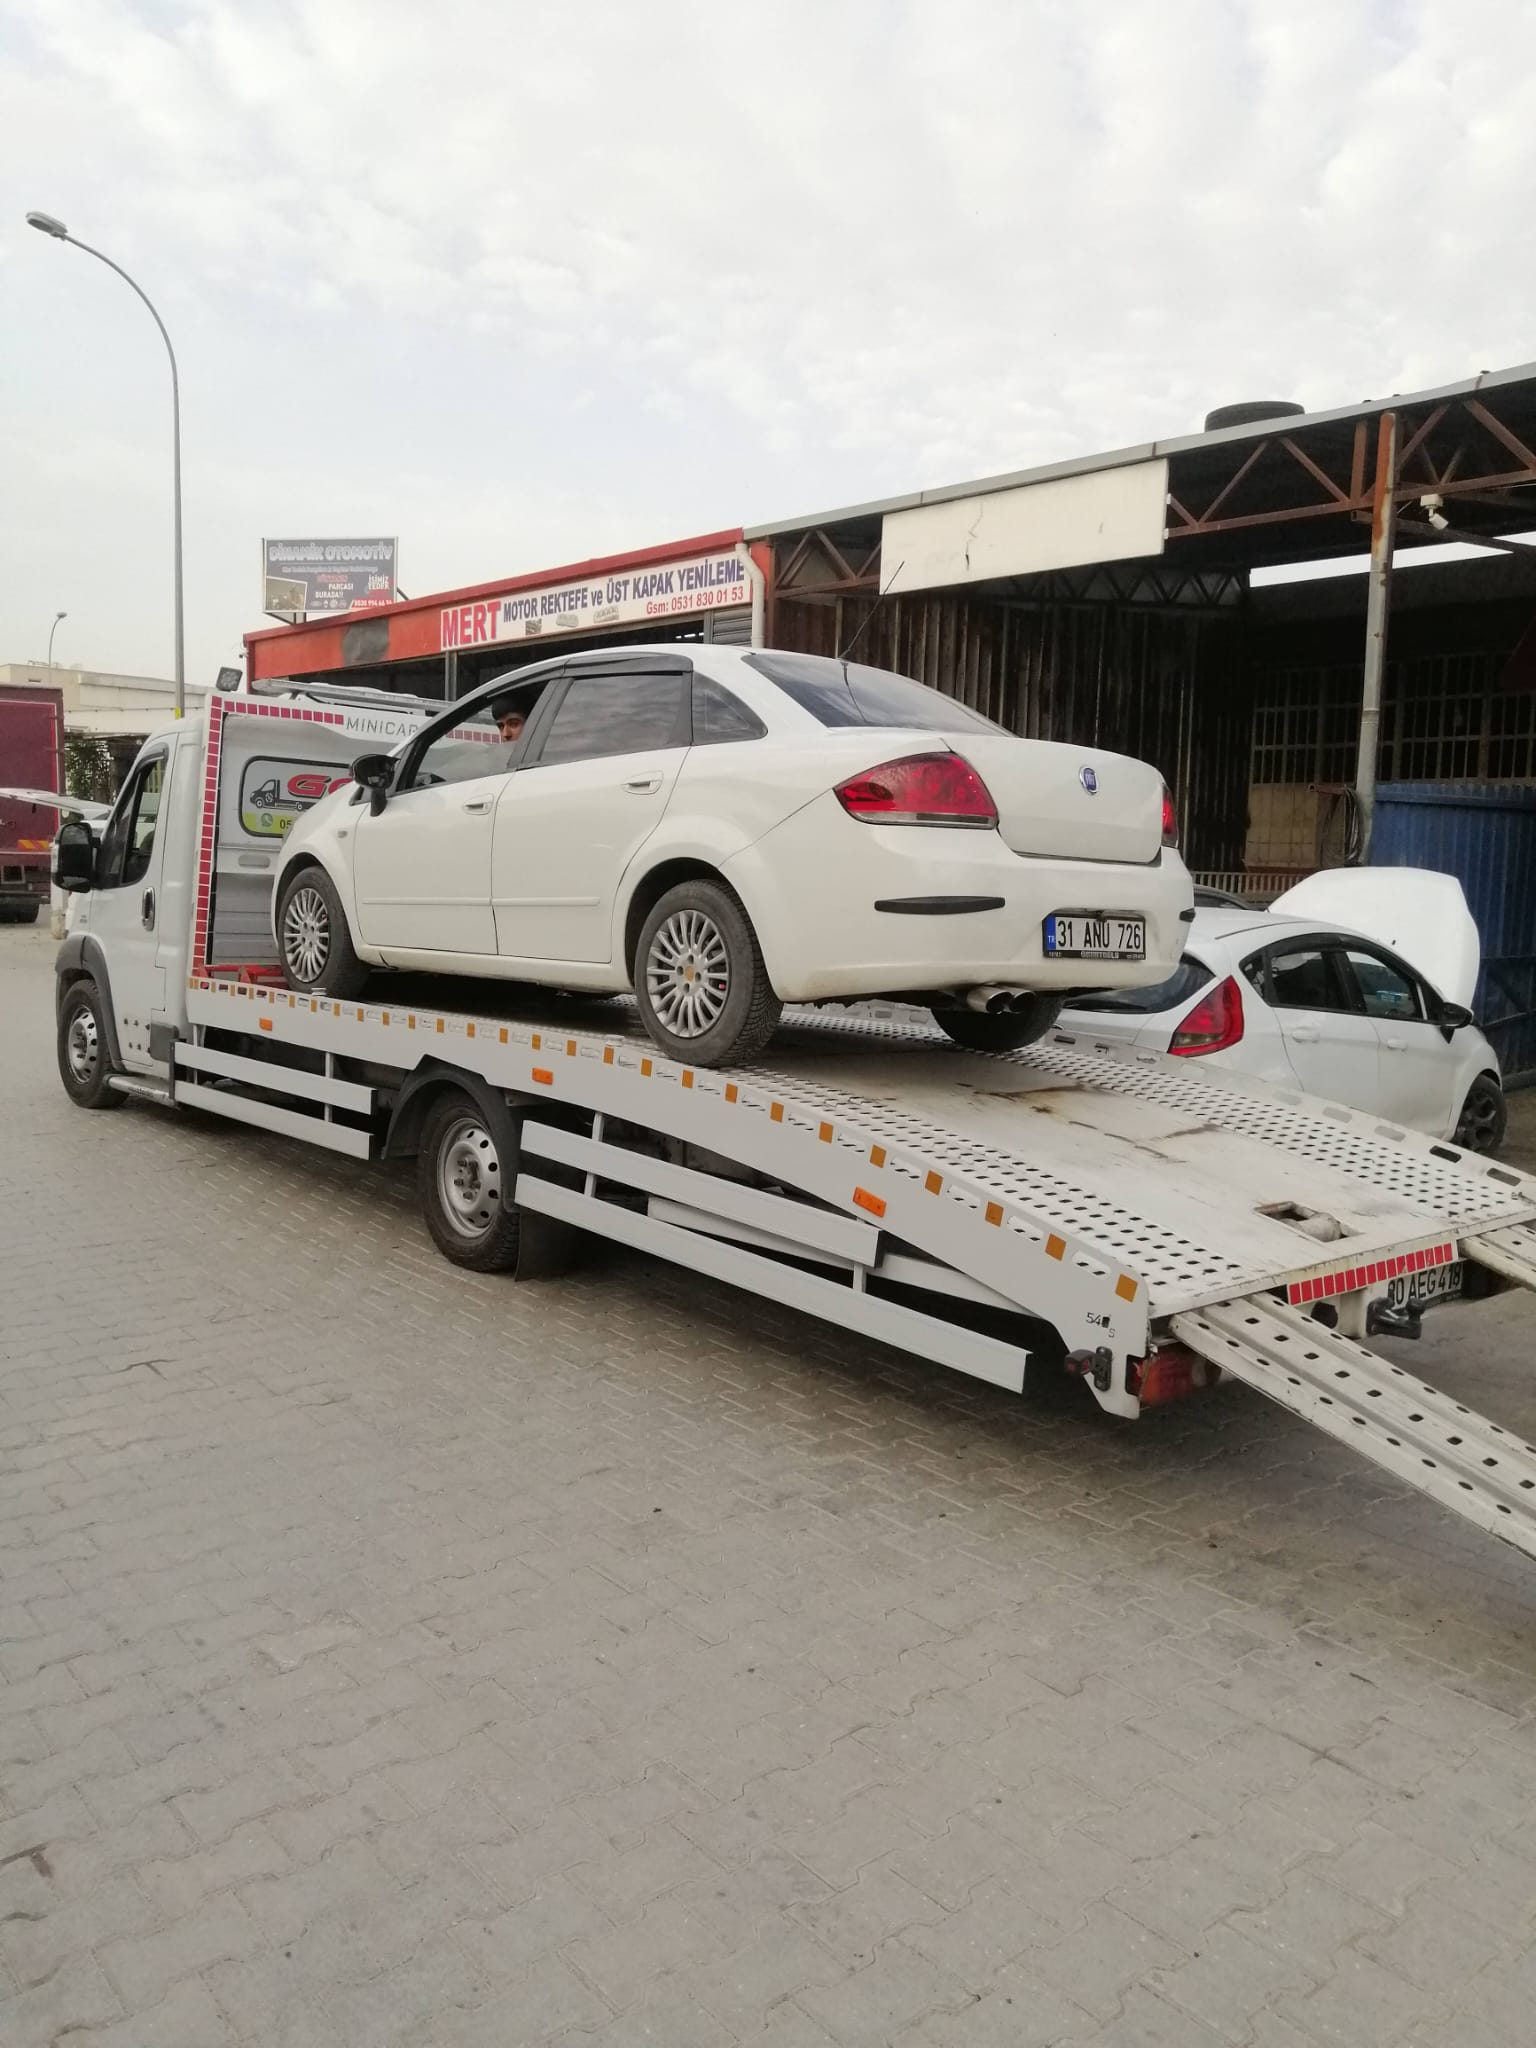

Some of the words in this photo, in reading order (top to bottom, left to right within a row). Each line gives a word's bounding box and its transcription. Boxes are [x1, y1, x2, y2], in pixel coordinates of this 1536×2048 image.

[325, 541, 393, 560] OTOMOTİV
[442, 600, 501, 648] MERT
[503, 597, 538, 623] MOTOR
[541, 587, 588, 616] REKTEFE
[591, 590, 603, 606] ve
[607, 577, 629, 604] ÜST
[632, 571, 674, 600] KAPAK
[678, 559, 745, 592] YENİLEME
[646, 602, 668, 615] Gsm:
[671, 593, 693, 611] 0531
[696, 591, 714, 604] 830
[717, 589, 728, 604] 01
[731, 586, 744, 601] 53
[1057, 920, 1073, 948] 31
[1083, 921, 1110, 948] ANU
[1117, 923, 1141, 950] 726
[1408, 1268, 1437, 1300] AEG
